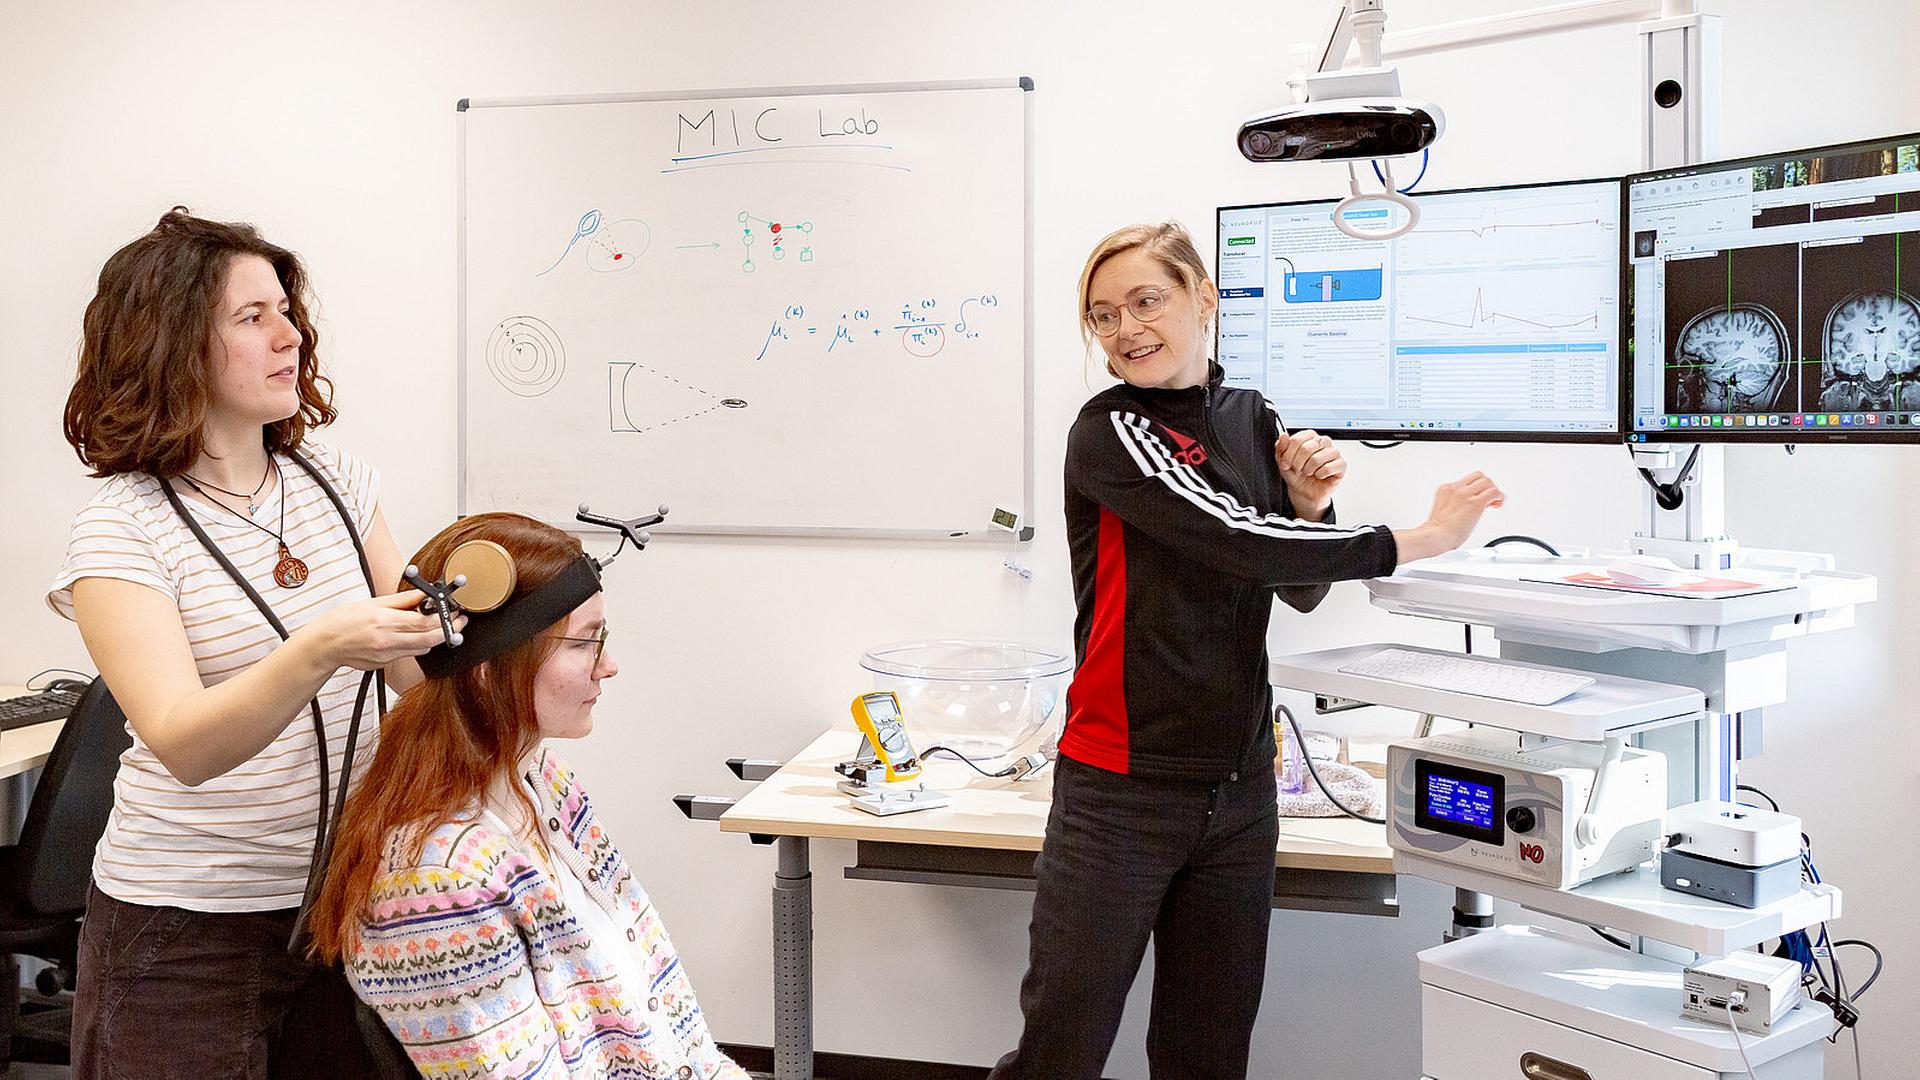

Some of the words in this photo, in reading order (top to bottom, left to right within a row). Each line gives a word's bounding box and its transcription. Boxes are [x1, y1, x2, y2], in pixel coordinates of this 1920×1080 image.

[677, 108, 782, 153] MIC
[818, 107, 879, 137] Lab
[1356, 130, 1377, 139] LYRA
[1229, 238, 1254, 246] Connected
[1519, 841, 1544, 864] NO
